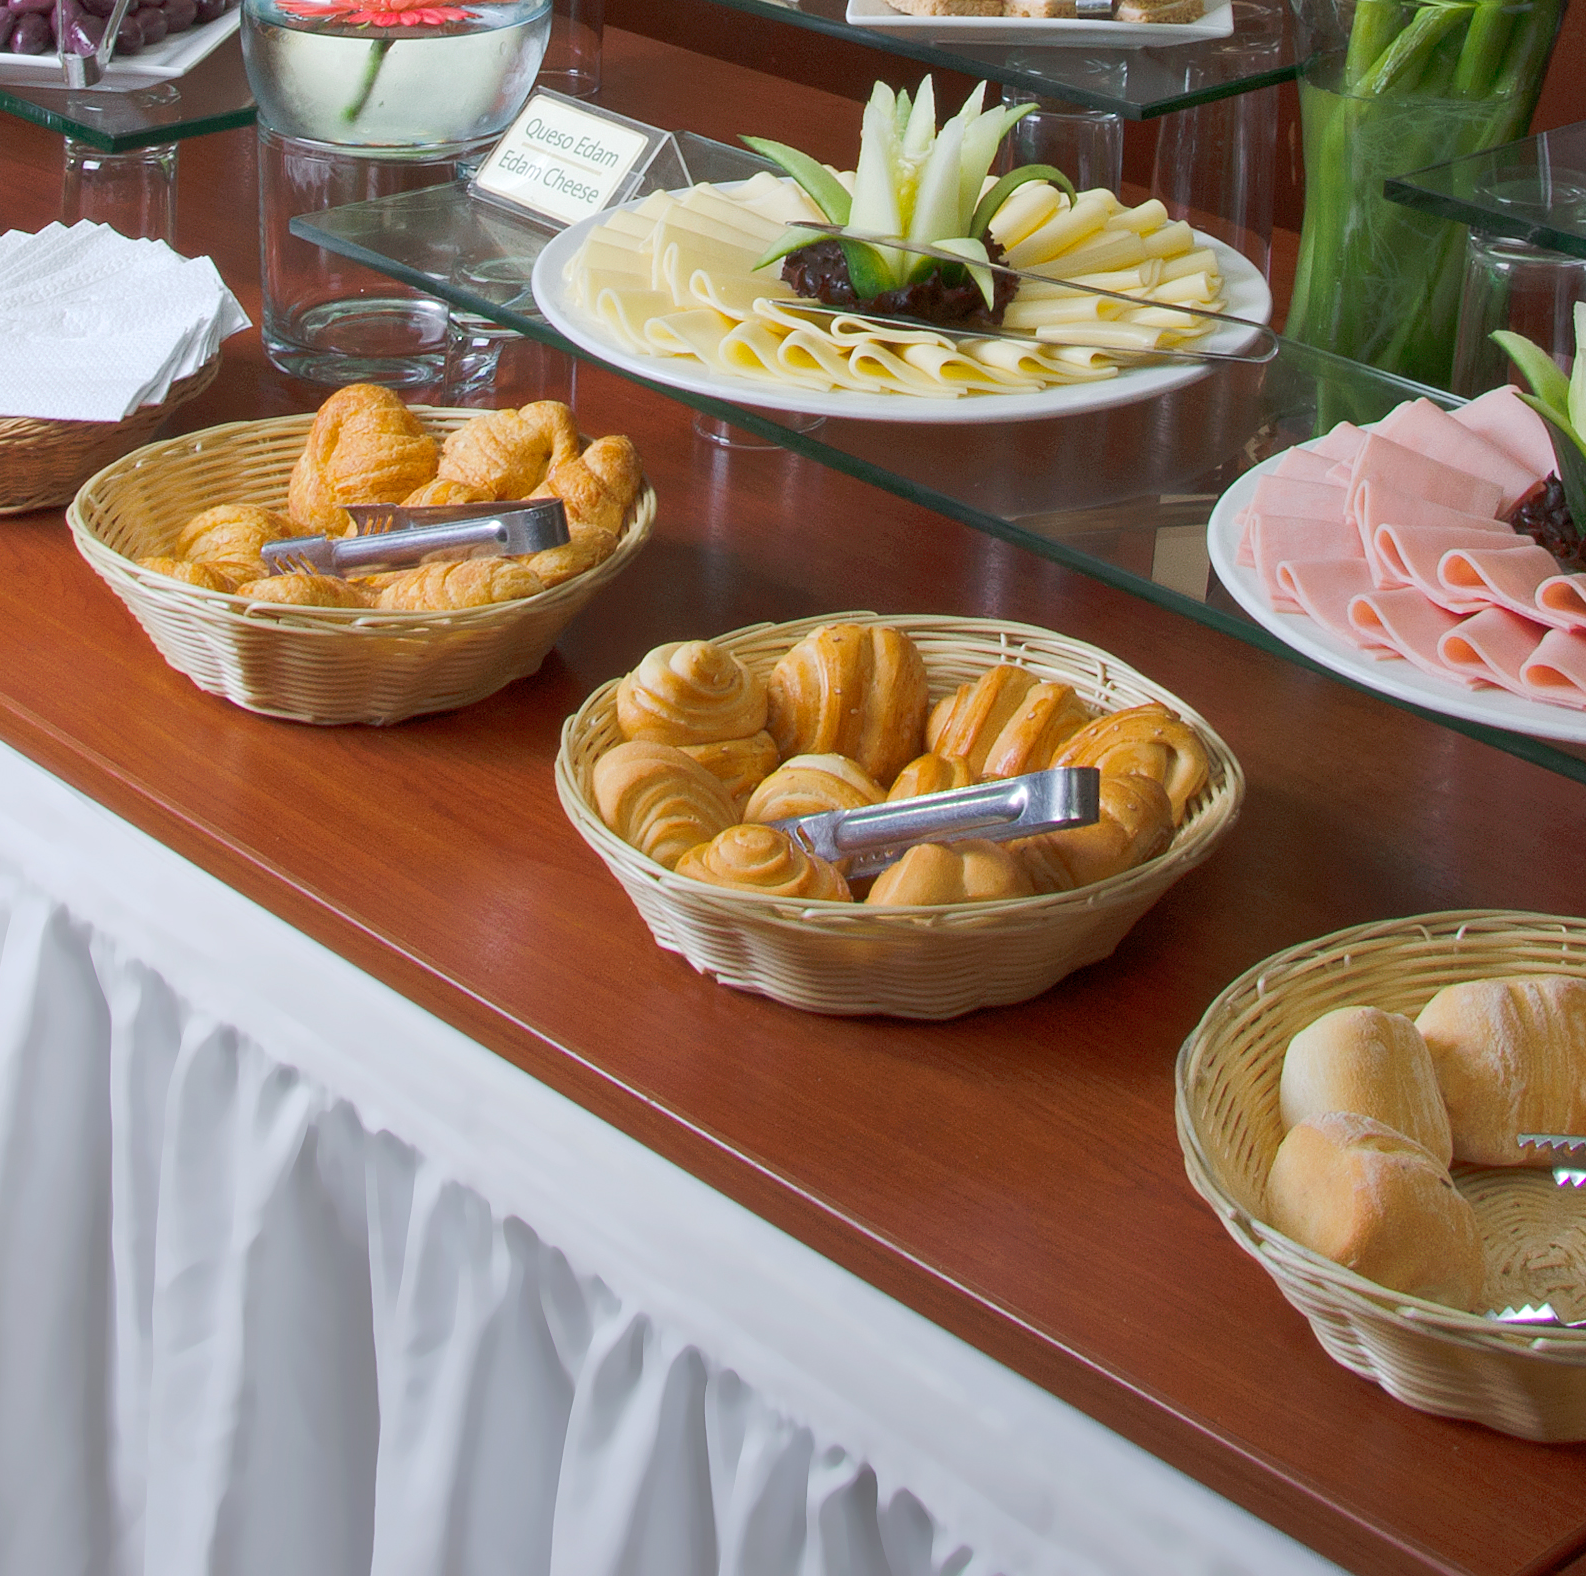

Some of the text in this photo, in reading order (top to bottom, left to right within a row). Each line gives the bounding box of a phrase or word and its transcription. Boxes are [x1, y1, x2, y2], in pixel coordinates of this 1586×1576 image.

[525, 118, 620, 168] Queso Edam
[497, 149, 600, 204] Edam Cheese
